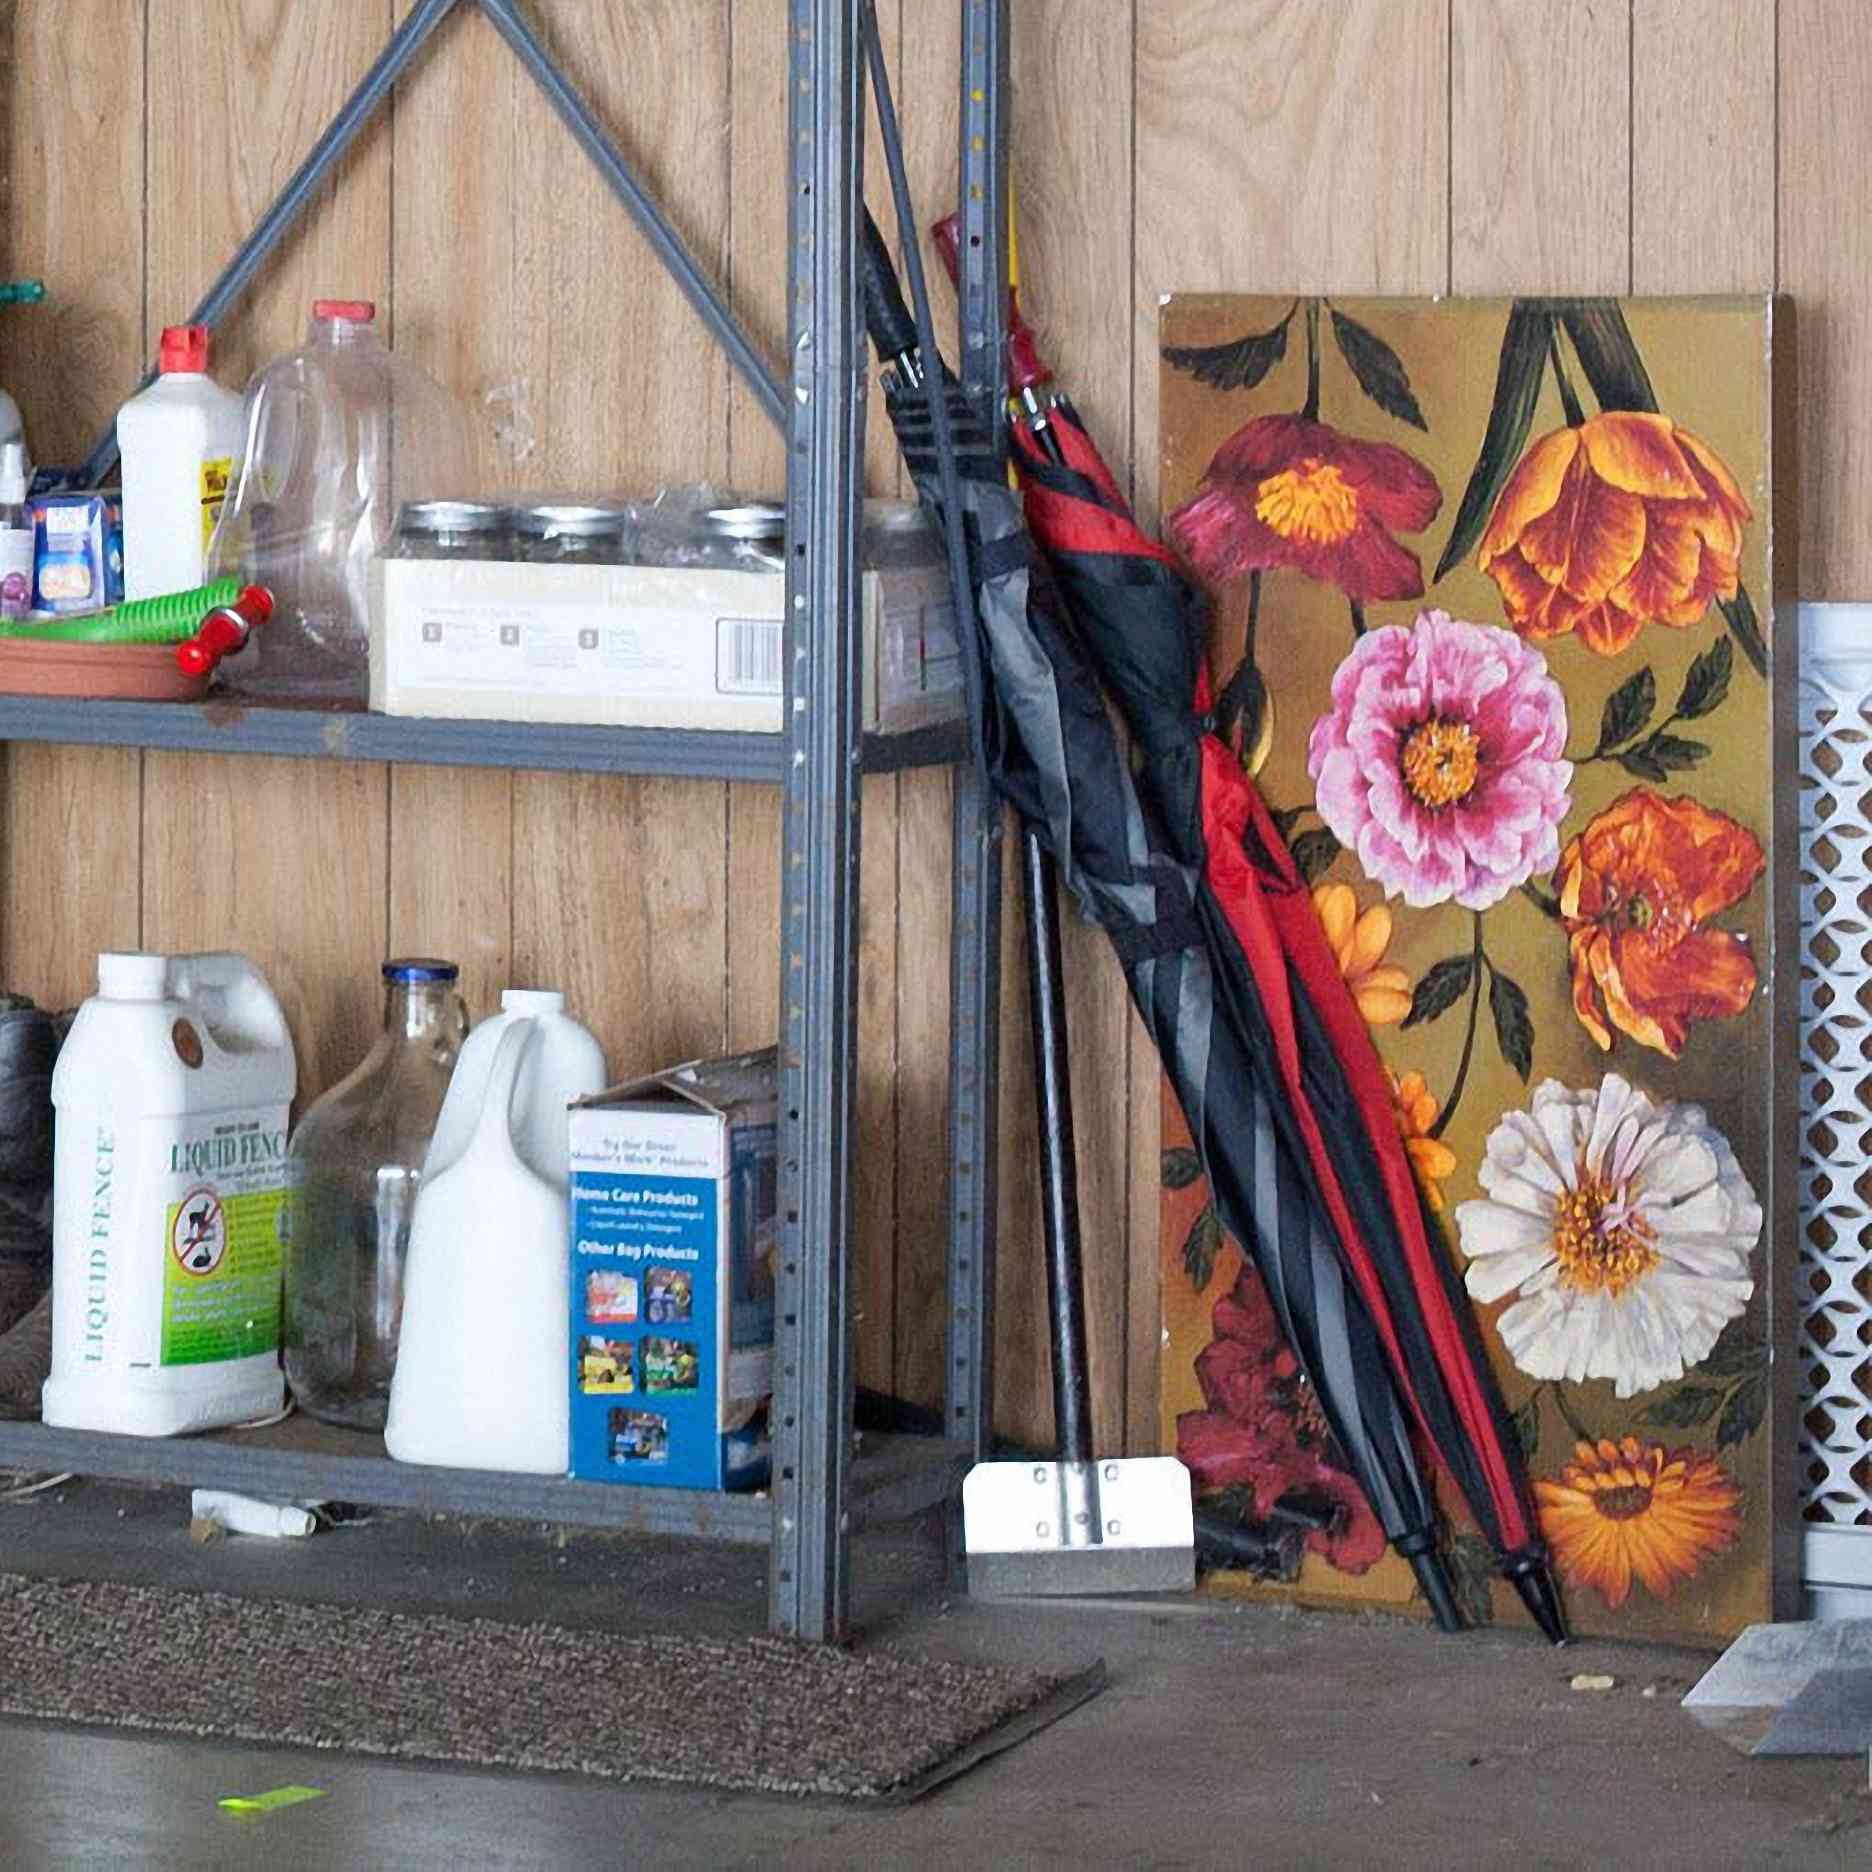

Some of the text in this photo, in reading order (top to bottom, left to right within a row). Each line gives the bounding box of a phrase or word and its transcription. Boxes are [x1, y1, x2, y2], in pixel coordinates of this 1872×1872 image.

[170, 1130, 286, 1177] LIQUID FENC
[612, 1188, 641, 1204] Care
[642, 1189, 699, 1207] Products
[84, 1134, 114, 1362] LIQUID FENCE
[577, 1239, 615, 1257] Other
[643, 1244, 700, 1261] Products
